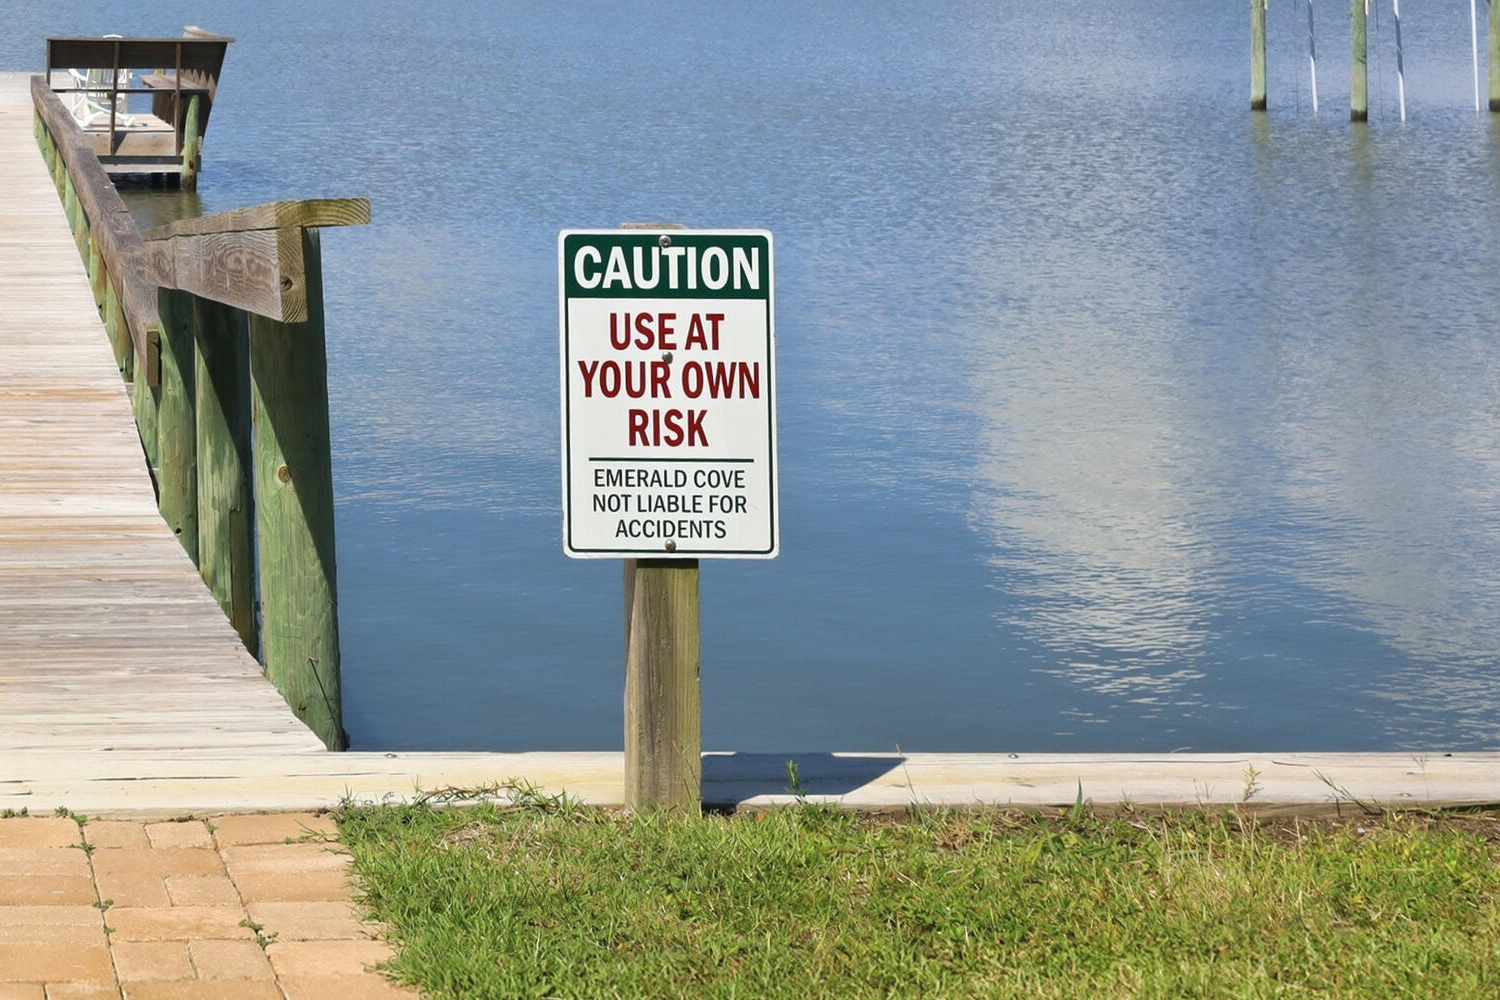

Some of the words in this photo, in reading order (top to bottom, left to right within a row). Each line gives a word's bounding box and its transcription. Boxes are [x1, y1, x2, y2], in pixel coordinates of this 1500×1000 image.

[573, 246, 760, 290] CAUTION
[609, 312, 677, 351] USE
[684, 313, 725, 351] AT
[577, 360, 672, 399] YOUR
[681, 361, 760, 400] OWN
[628, 408, 709, 447] RISK
[594, 468, 687, 489] EMERALD
[693, 469, 746, 489] COVE
[592, 493, 633, 513] NOT
[637, 494, 703, 514] LIABLE
[708, 494, 747, 514] FOR
[615, 518, 727, 539] ACCIDENTS
